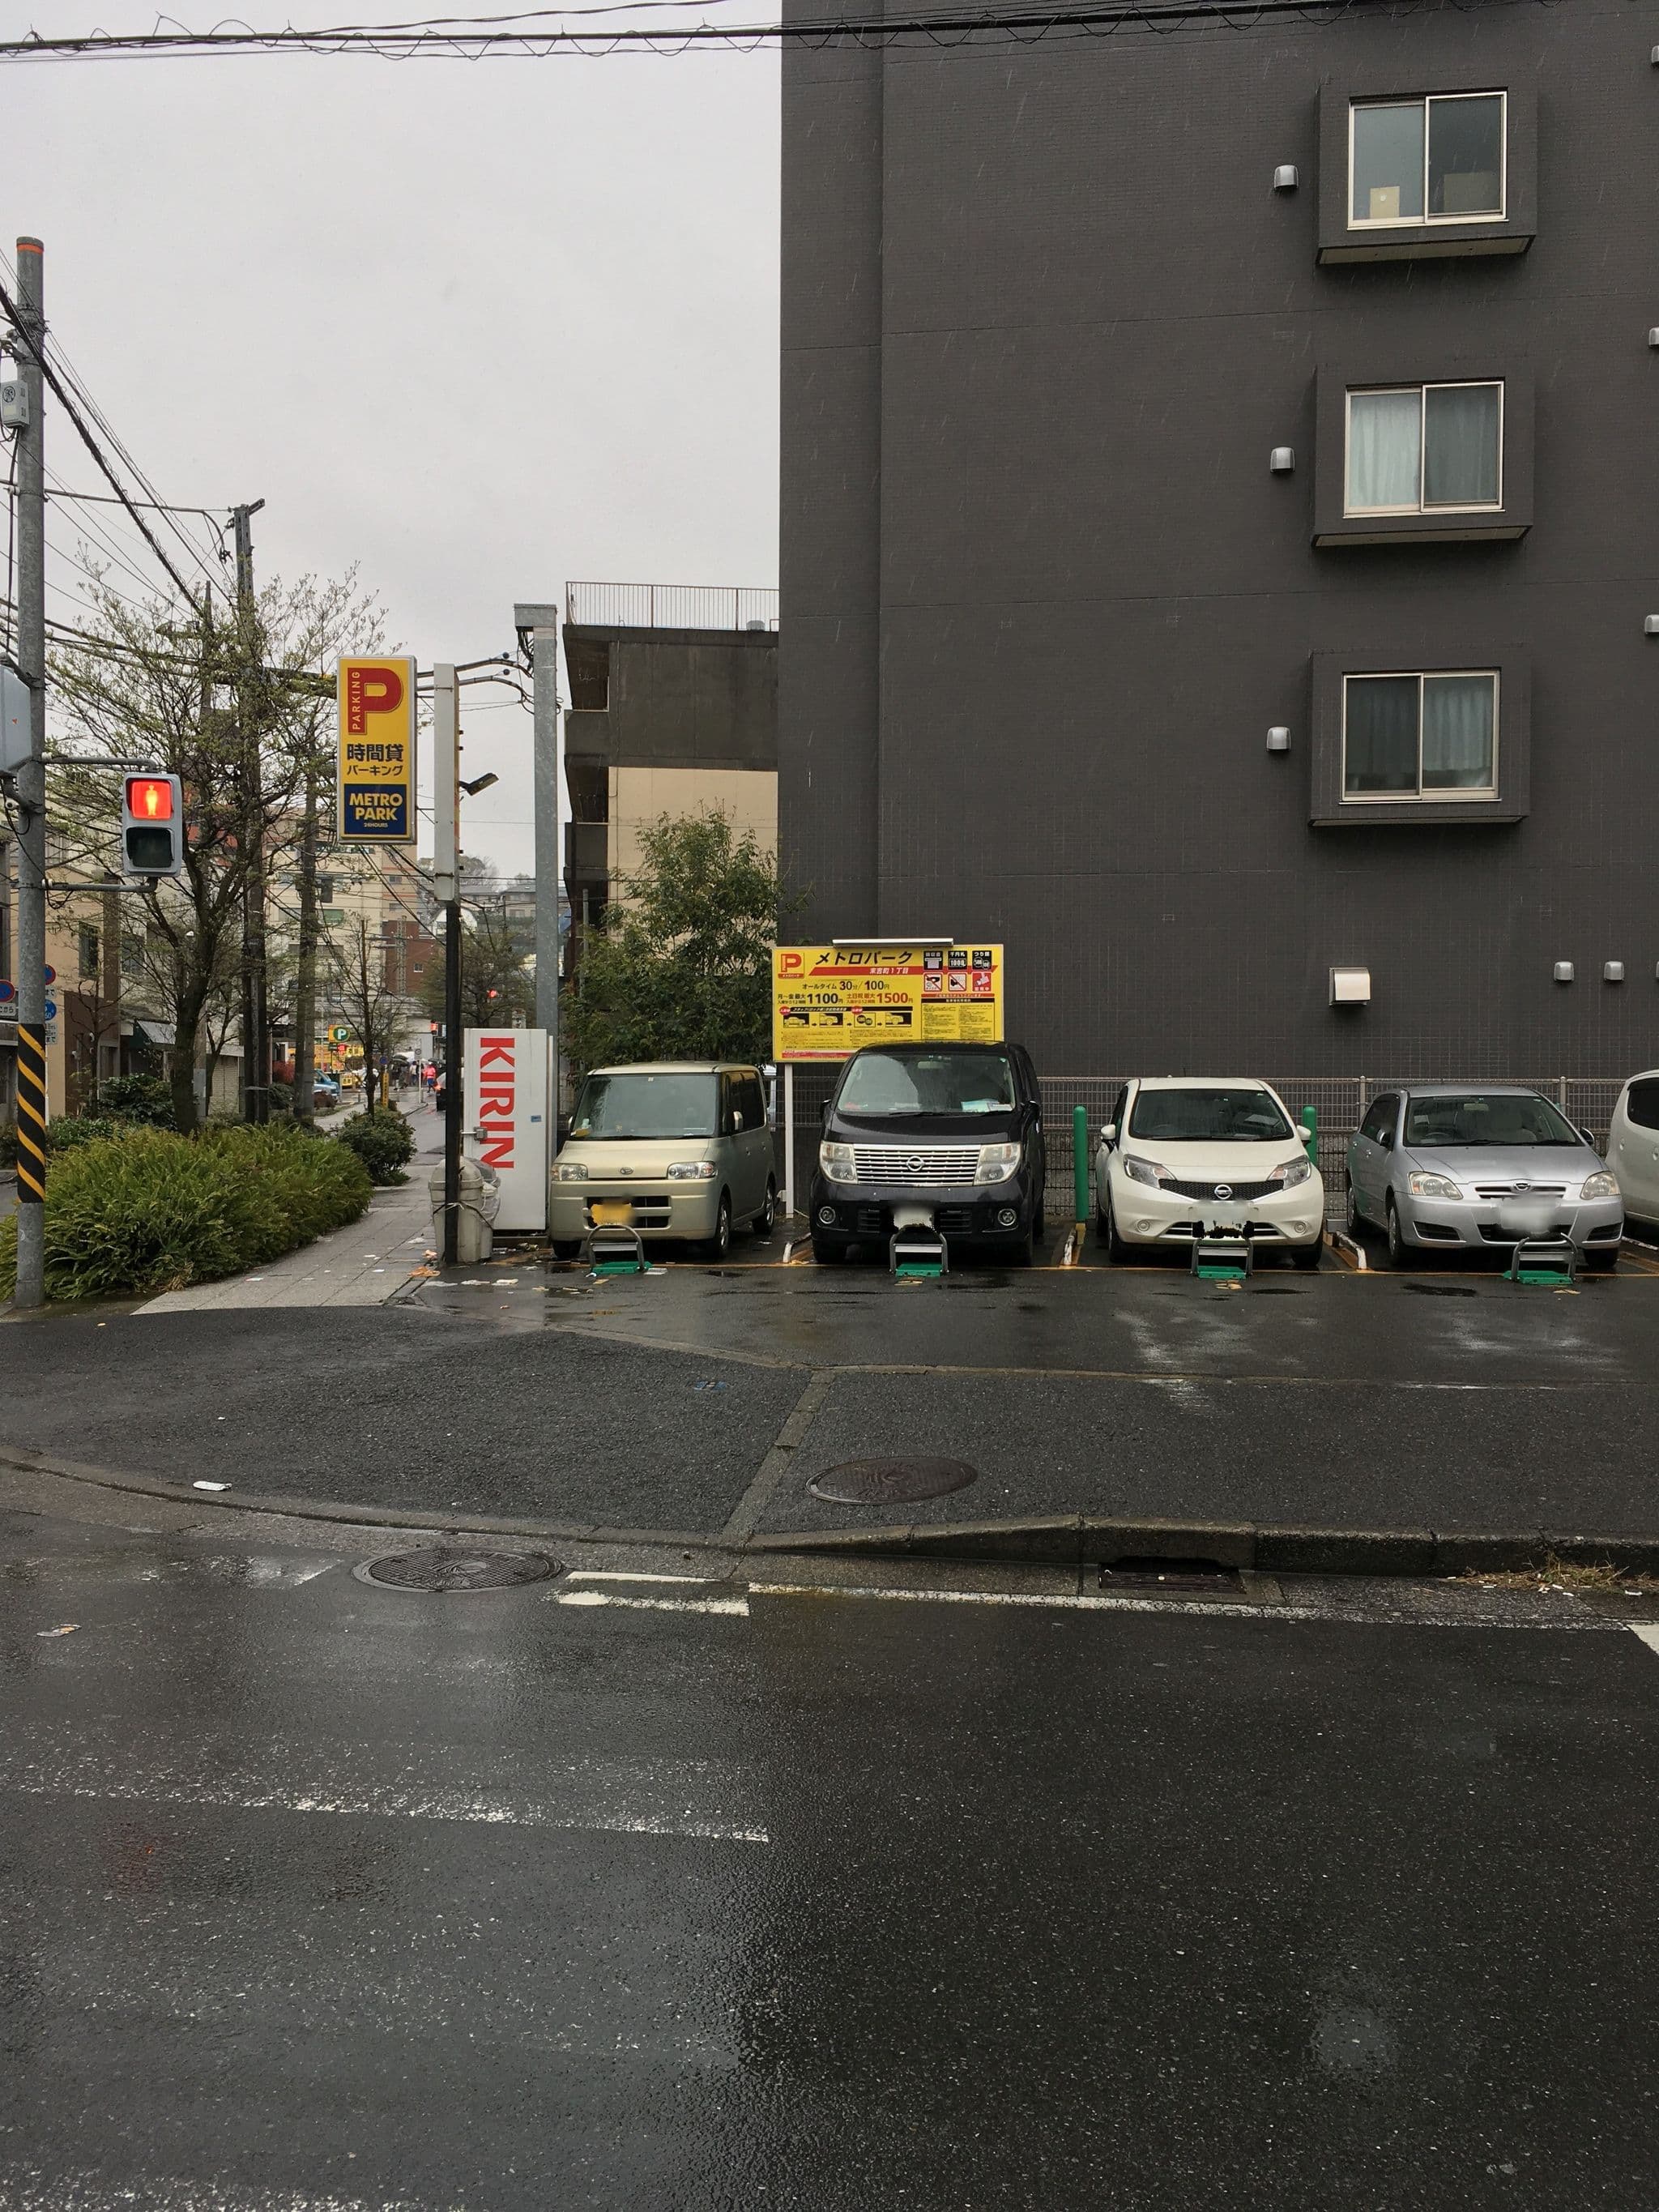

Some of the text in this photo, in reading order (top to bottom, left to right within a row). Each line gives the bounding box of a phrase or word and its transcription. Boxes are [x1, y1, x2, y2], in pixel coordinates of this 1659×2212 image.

[348, 668, 403, 734] P
[351, 671, 360, 730] PARKING
[347, 743, 403, 762] 時間貸
[347, 765, 403, 775] パーキング
[349, 793, 403, 806] METRO
[355, 807, 398, 820] PARK
[781, 954, 802, 972] P
[815, 951, 913, 965] メトロパーク
[337, 1028, 346, 1040] P
[480, 1037, 515, 1168] KIRIN
